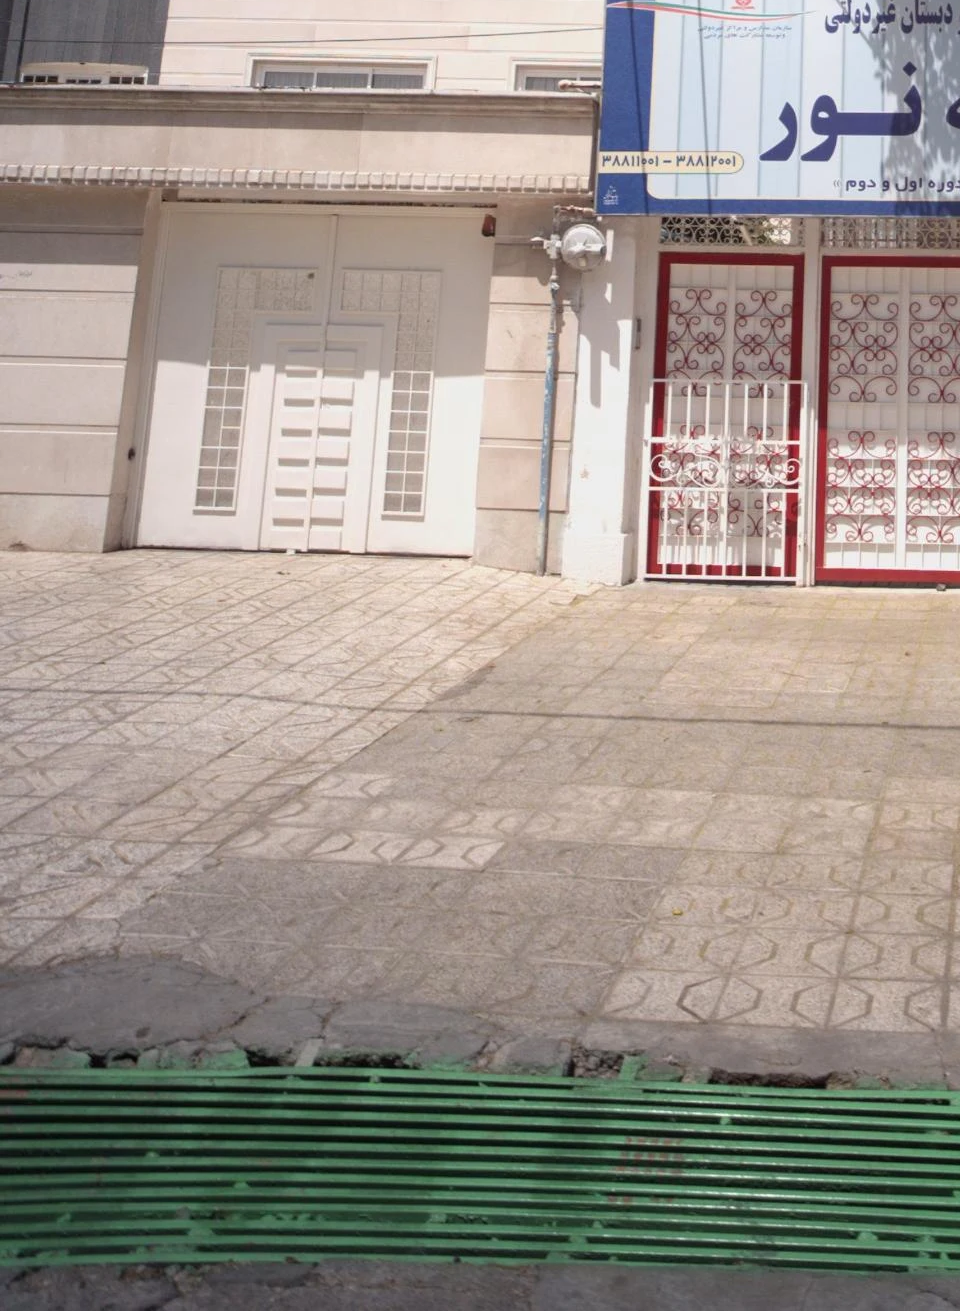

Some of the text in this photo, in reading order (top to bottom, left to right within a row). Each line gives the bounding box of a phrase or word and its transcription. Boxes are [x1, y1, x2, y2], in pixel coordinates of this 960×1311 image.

[602, 155, 659, 167] ۳۸۸۱۱۰۰۱
[676, 155, 737, 167] ۳۸۸۱۲۰۰۱
[845, 179, 877, 191] دوم
[881, 180, 891, 191] و
[895, 178, 924, 192] اول
